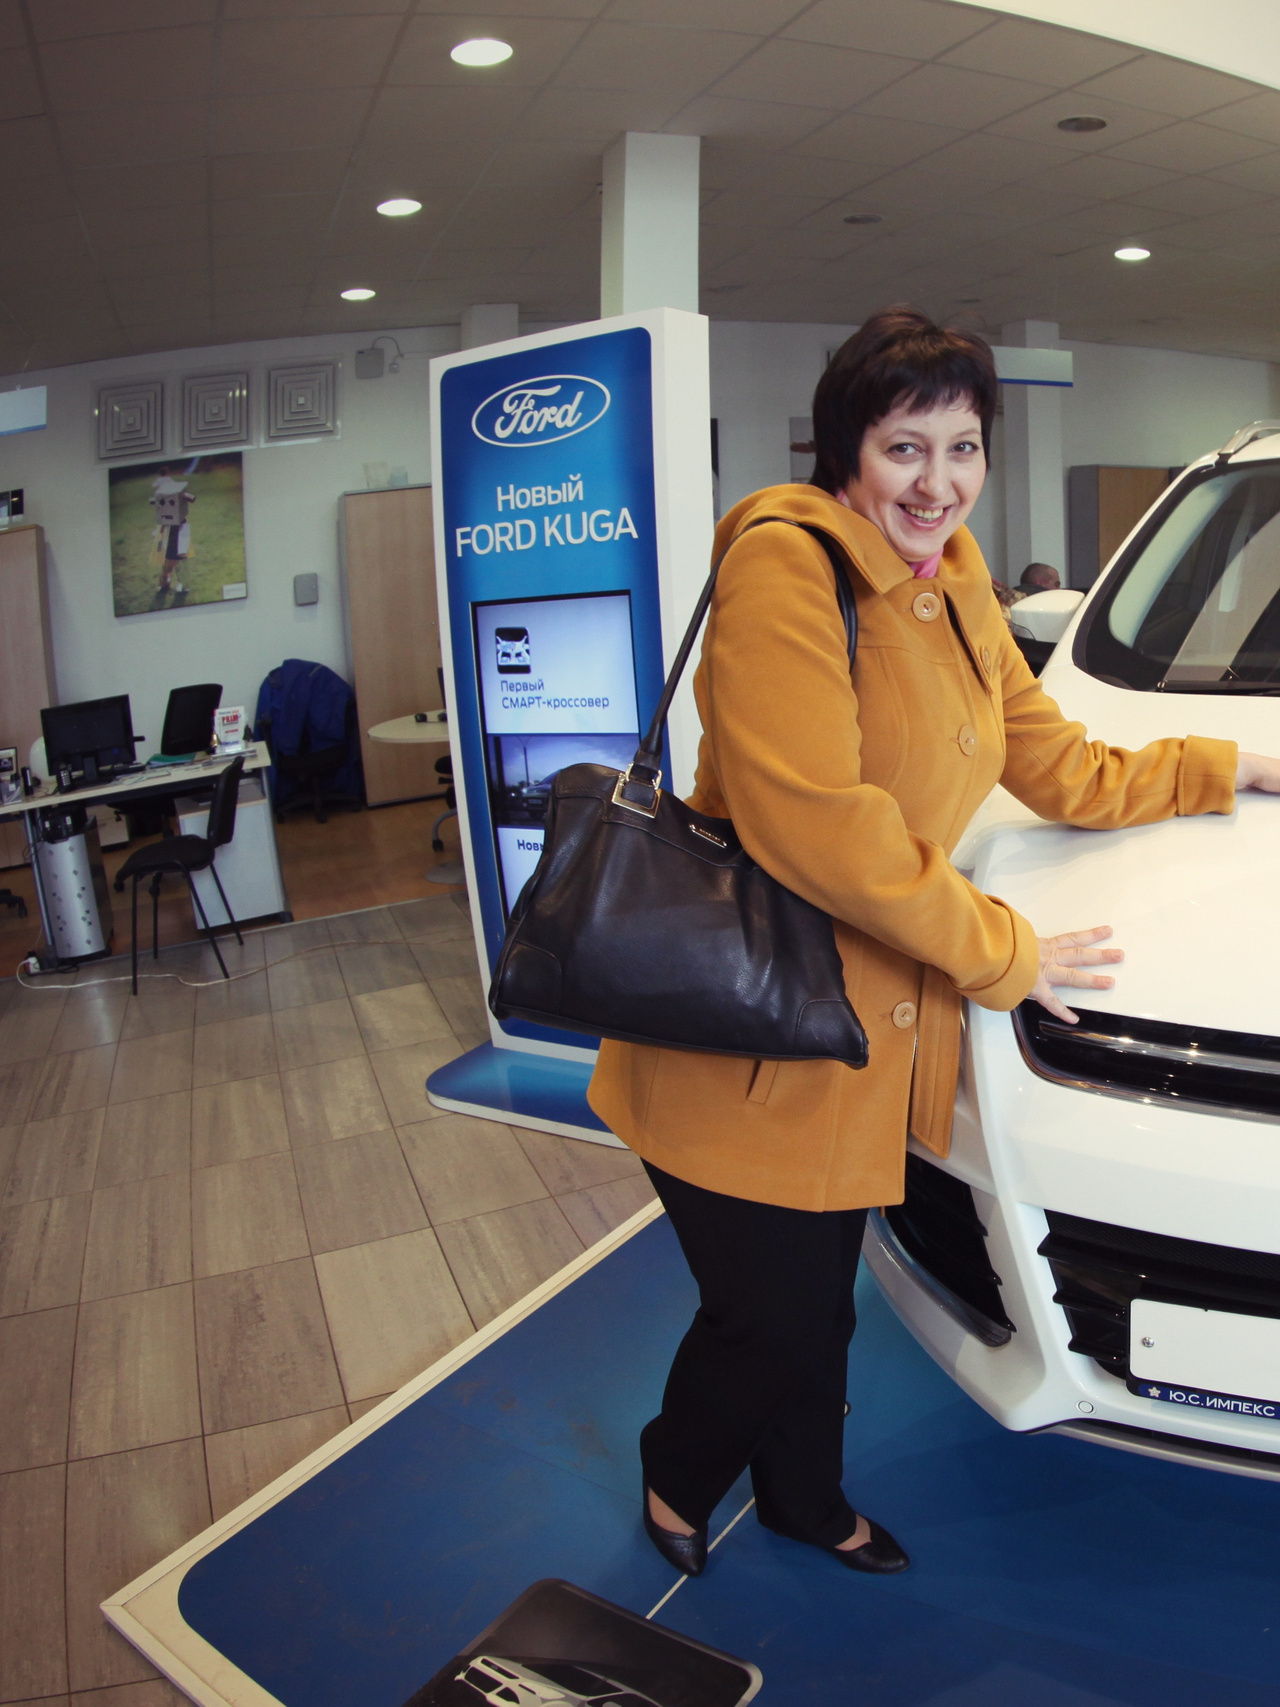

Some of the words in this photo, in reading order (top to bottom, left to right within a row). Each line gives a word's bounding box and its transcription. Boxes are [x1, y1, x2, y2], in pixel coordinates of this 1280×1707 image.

[494, 385, 584, 438] Ford
[497, 473, 584, 511] Новый
[455, 519, 536, 557] FORD
[544, 507, 638, 546] KUGA
[500, 679, 544, 692] Первый
[501, 696, 609, 709] СМАРТ-кроссовер
